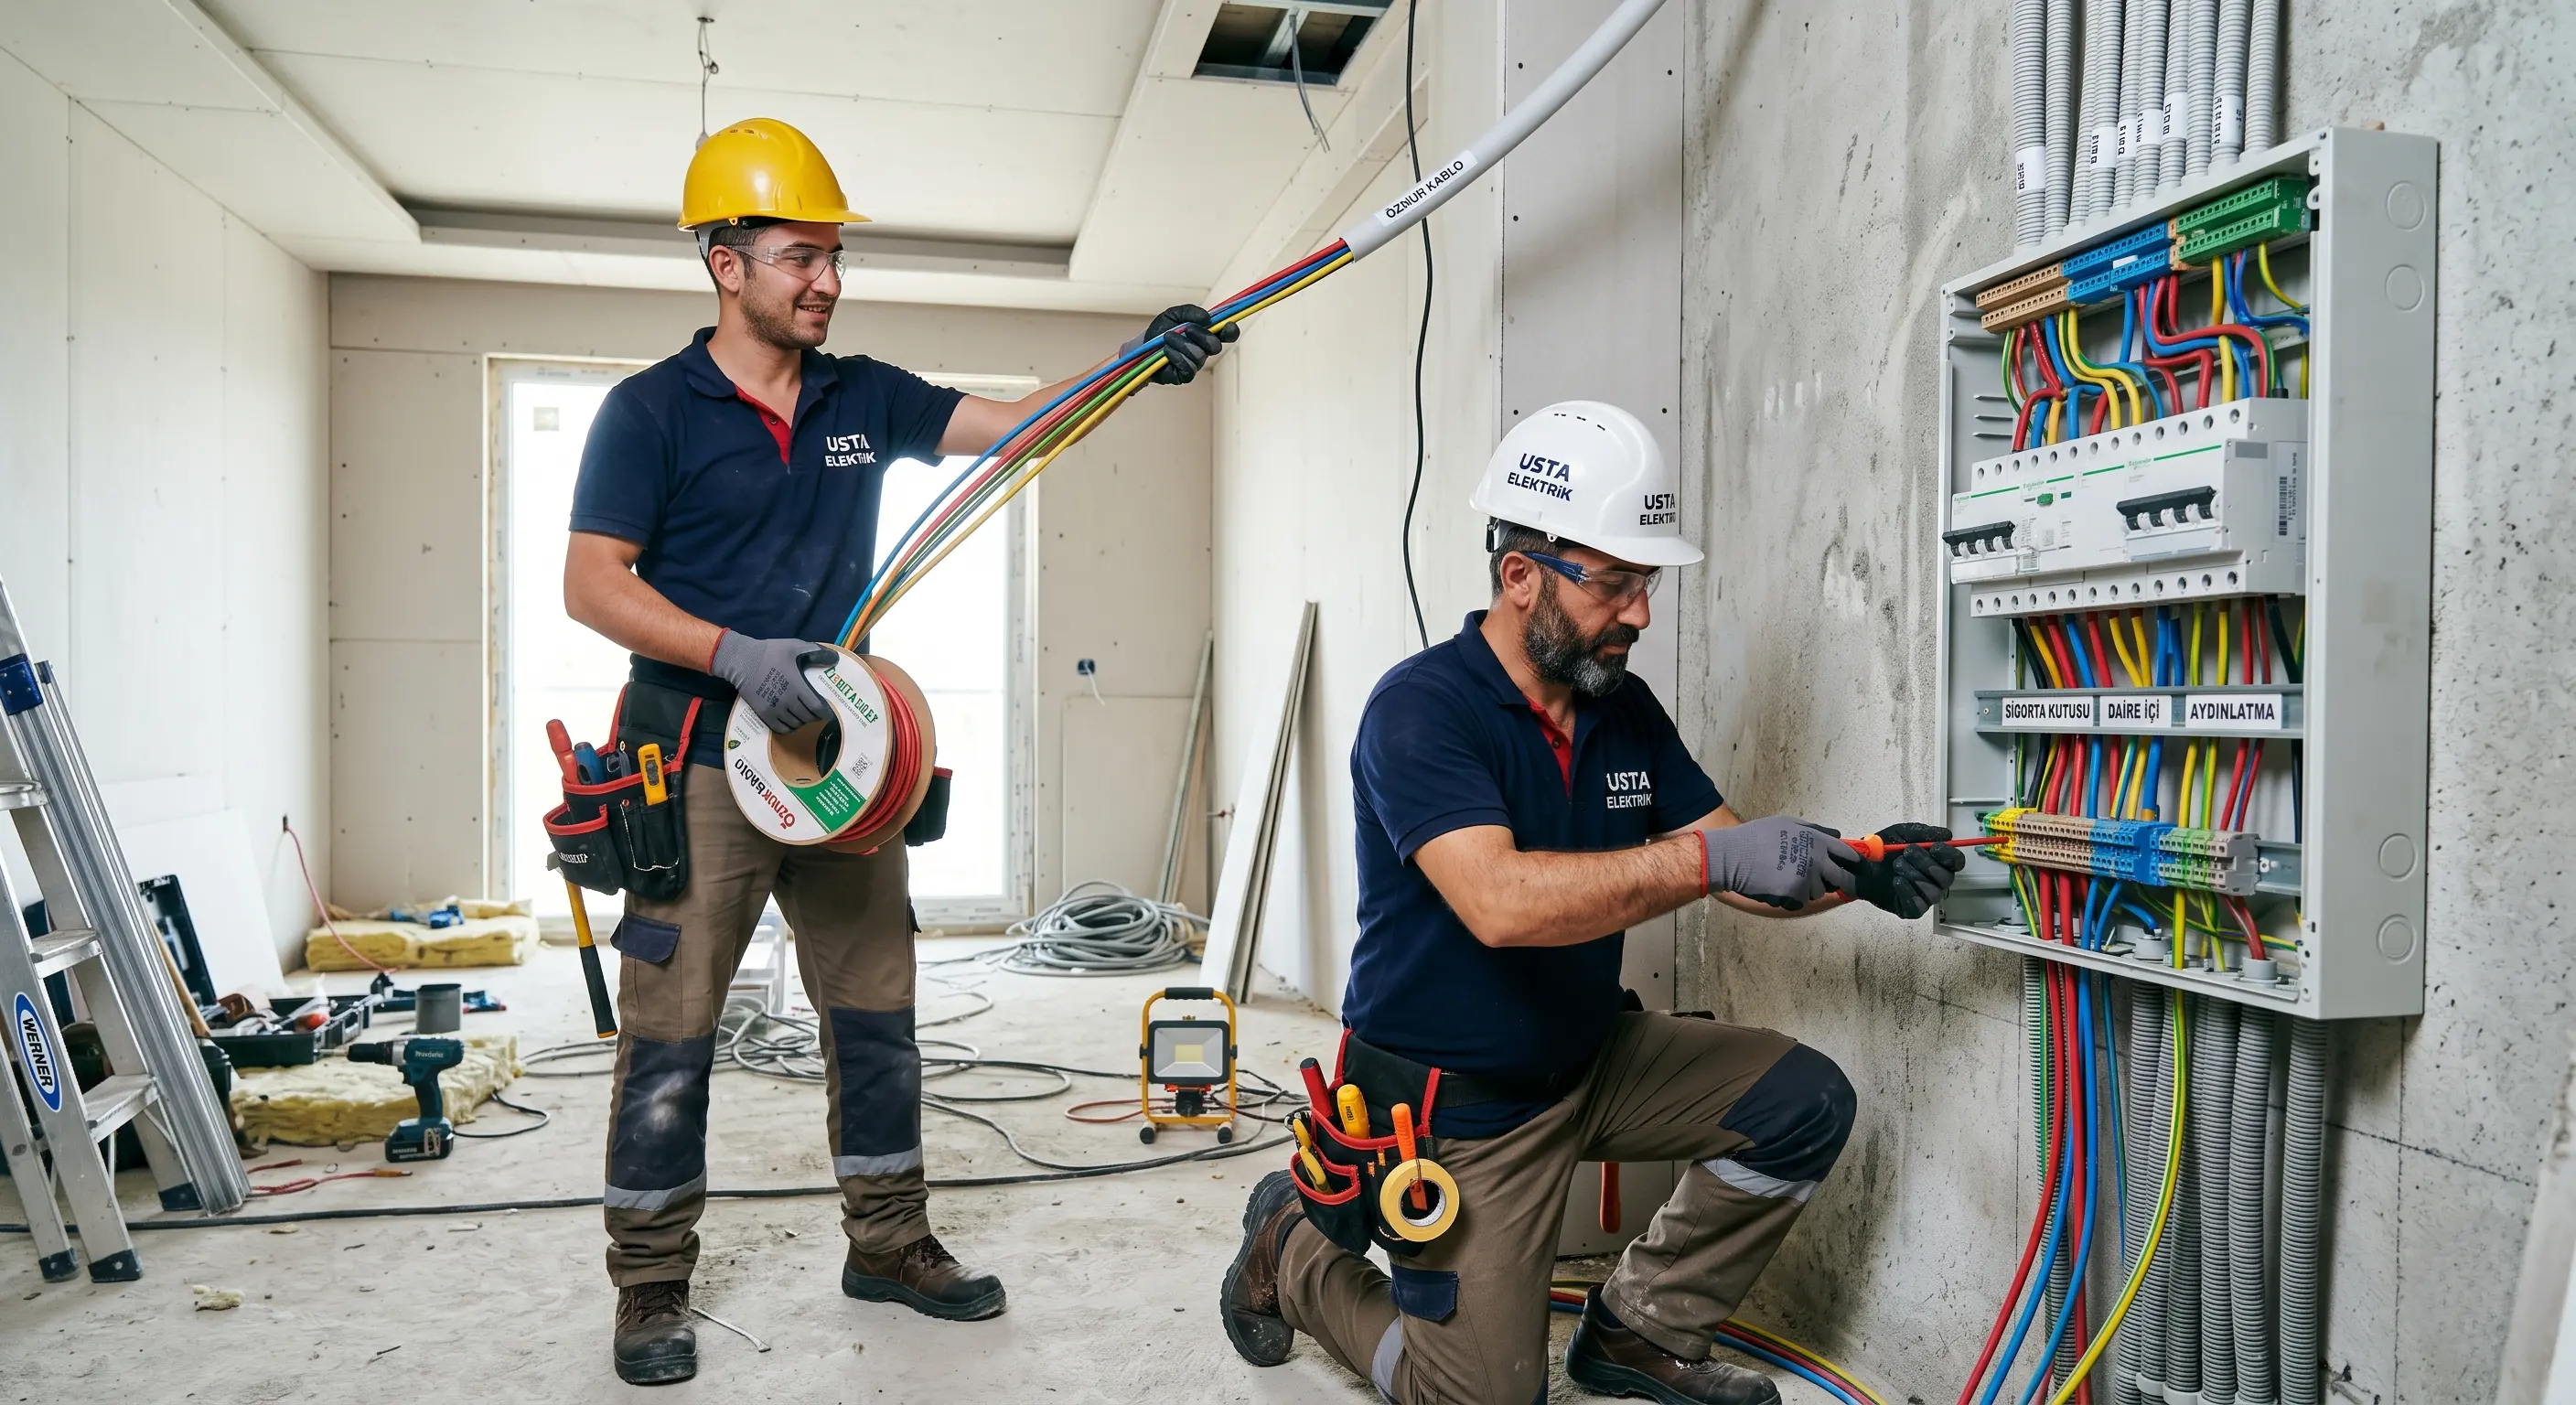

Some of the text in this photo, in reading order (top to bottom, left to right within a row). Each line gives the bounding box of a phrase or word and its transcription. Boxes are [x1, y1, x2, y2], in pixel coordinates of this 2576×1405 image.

[1425, 160, 1464, 191] KABLO
[826, 434, 871, 452] USTA
[1519, 453, 1571, 482] USTA
[1644, 493, 1676, 510] USTA
[2005, 700, 2090, 719] SİGORTA KUTUSU
[2108, 698, 2160, 724] DAİRE İÇİ
[2190, 702, 2275, 721] AYDINLATMA
[1605, 771, 1651, 791] USTA
[22, 1017, 53, 1088] WERNER
